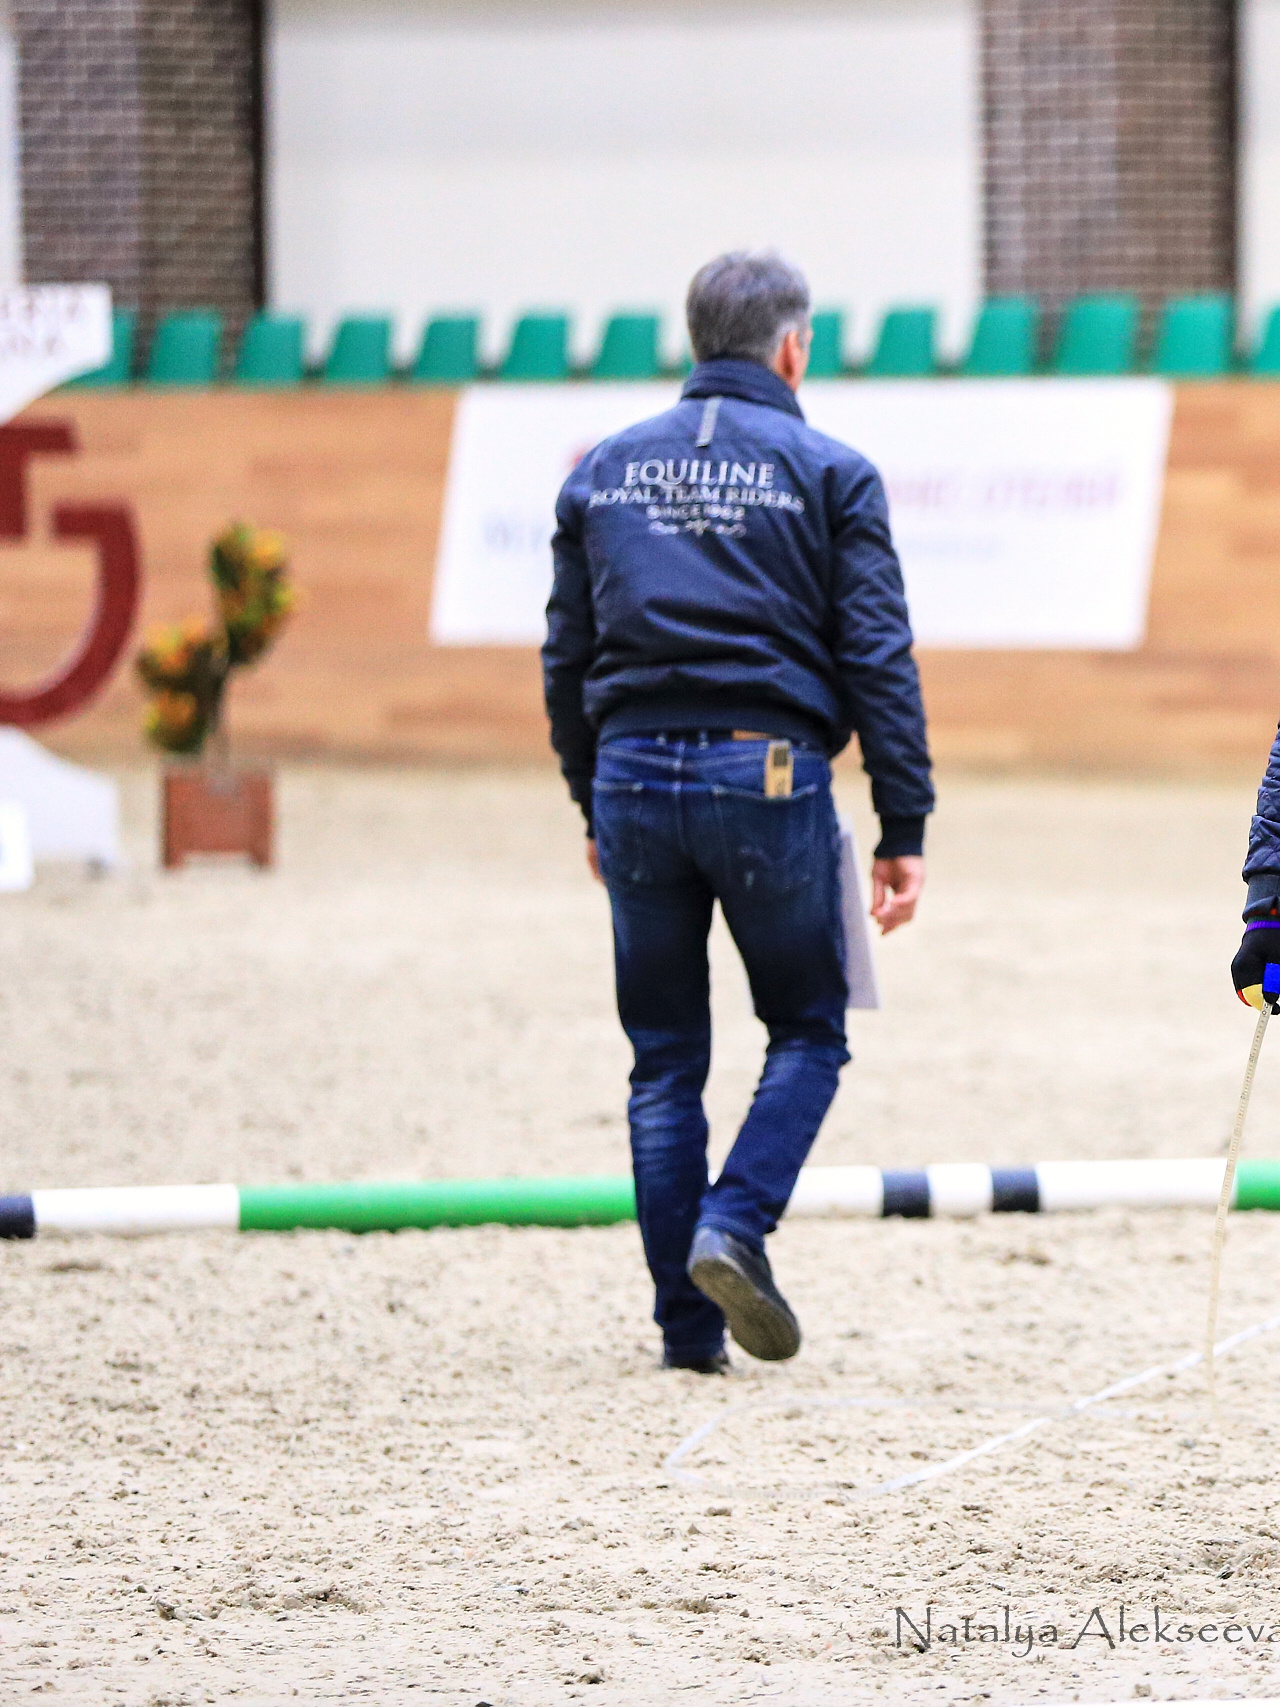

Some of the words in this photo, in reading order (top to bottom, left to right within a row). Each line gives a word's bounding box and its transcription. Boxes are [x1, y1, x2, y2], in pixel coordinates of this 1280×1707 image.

[624, 458, 775, 488] EQUILINE
[588, 486, 658, 508] ROYAL
[663, 485, 720, 504] TEAM
[725, 486, 805, 515] RIDERS
